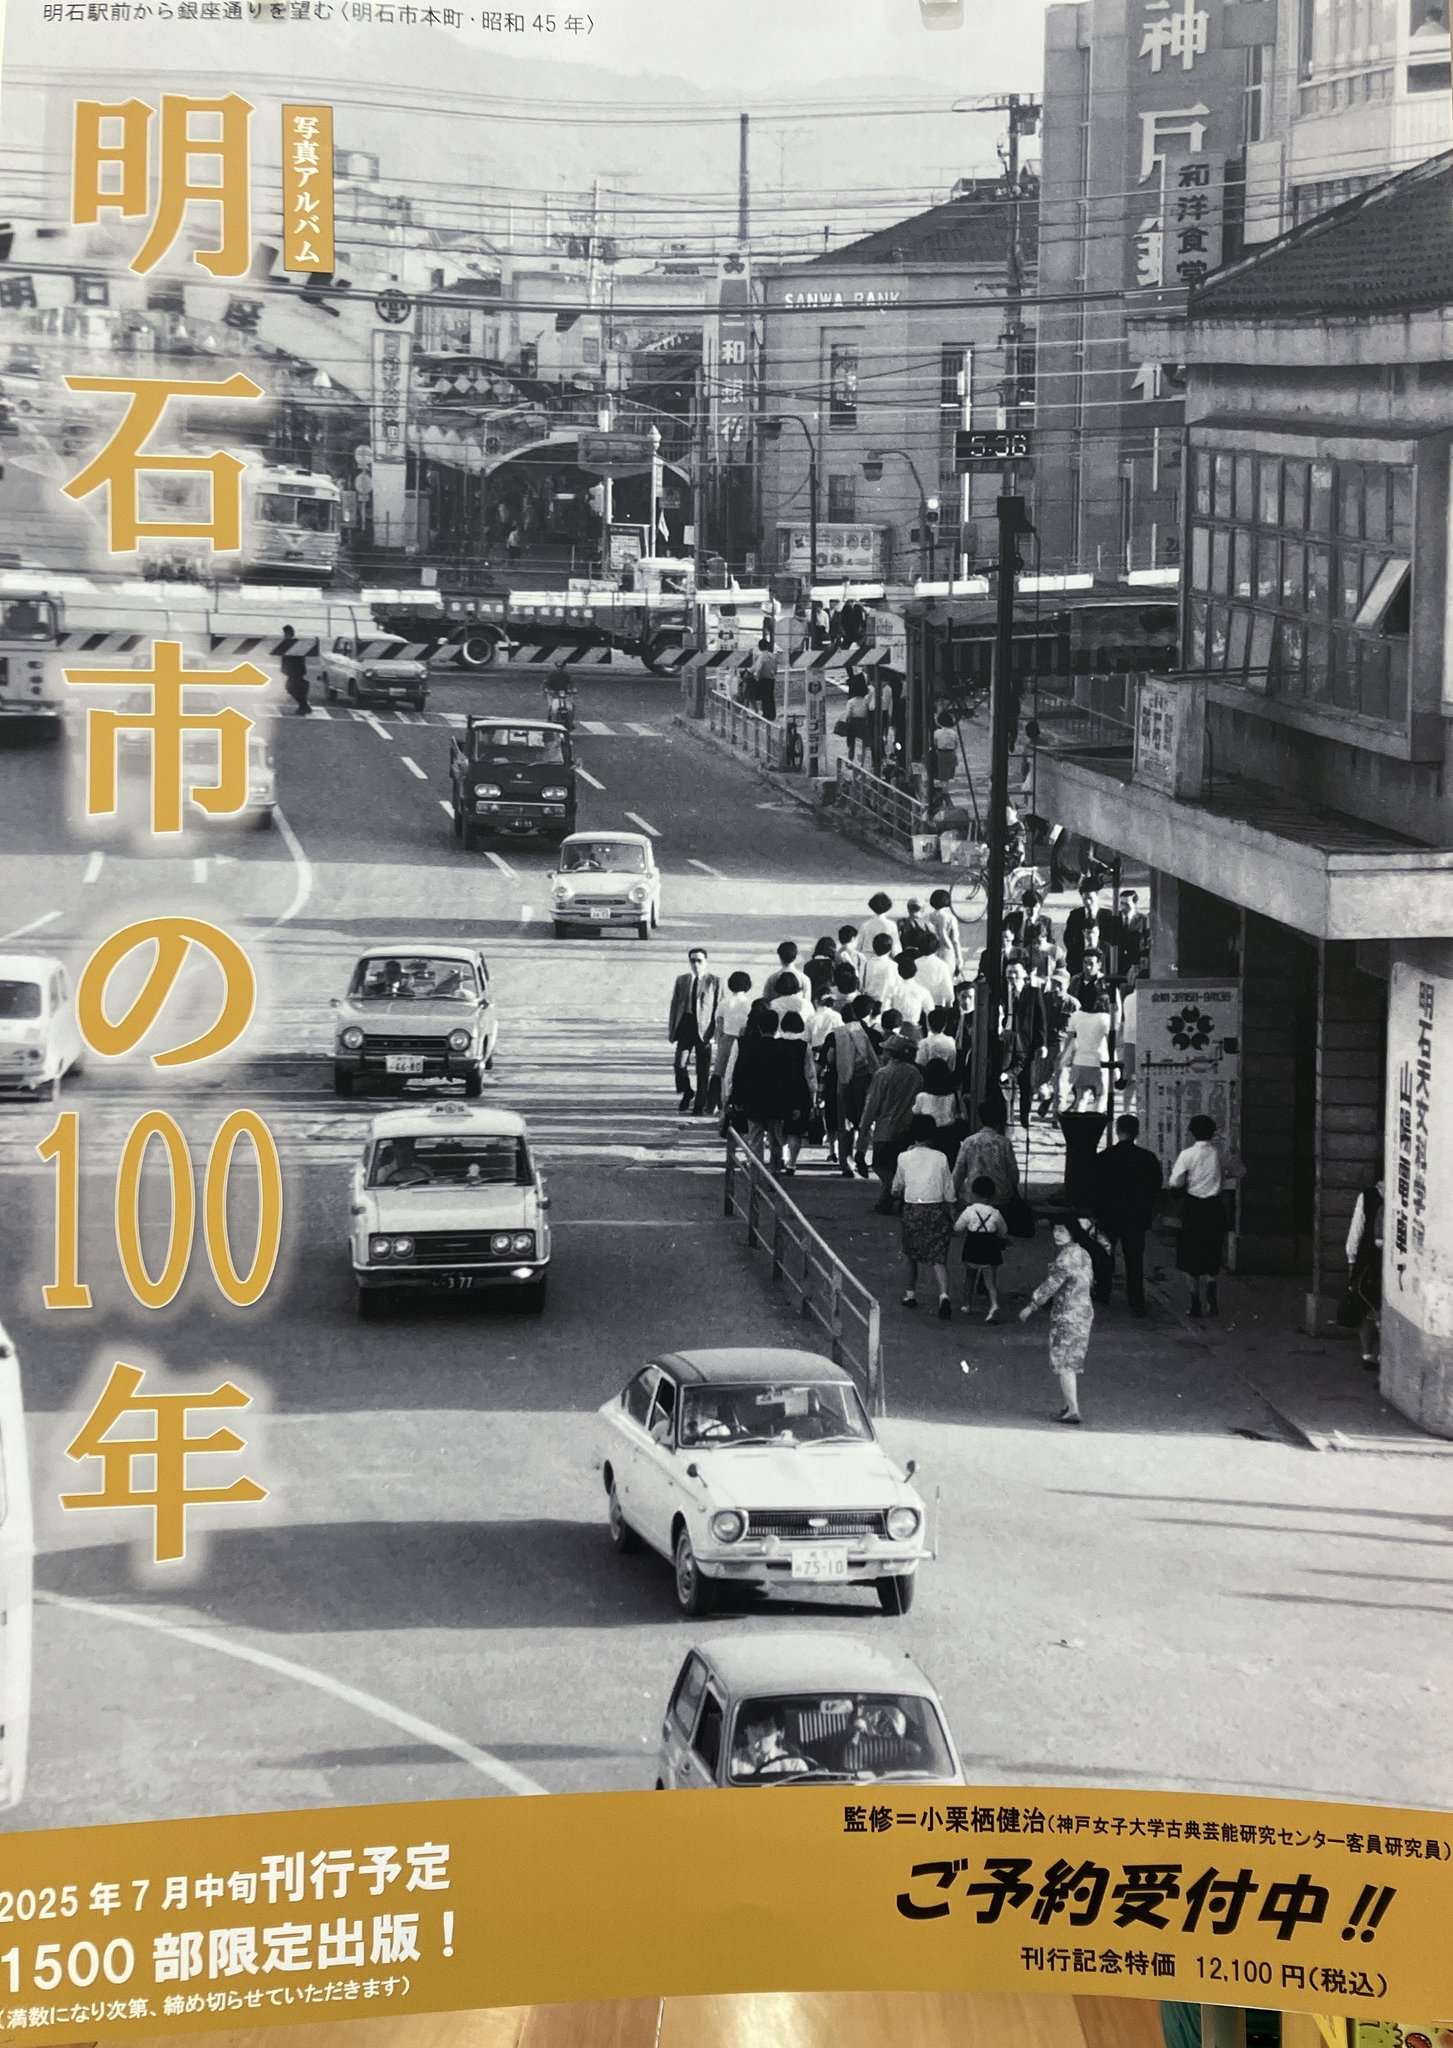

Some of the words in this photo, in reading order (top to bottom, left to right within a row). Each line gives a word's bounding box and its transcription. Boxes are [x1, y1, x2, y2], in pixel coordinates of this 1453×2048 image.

[293, 115, 321, 264] 写真アルバム
[784, 291, 844, 309] SANWA
[896, 1857, 1397, 1943] ご予約受付中!!
[1020, 1946, 1177, 1979] 刊行記念特価
